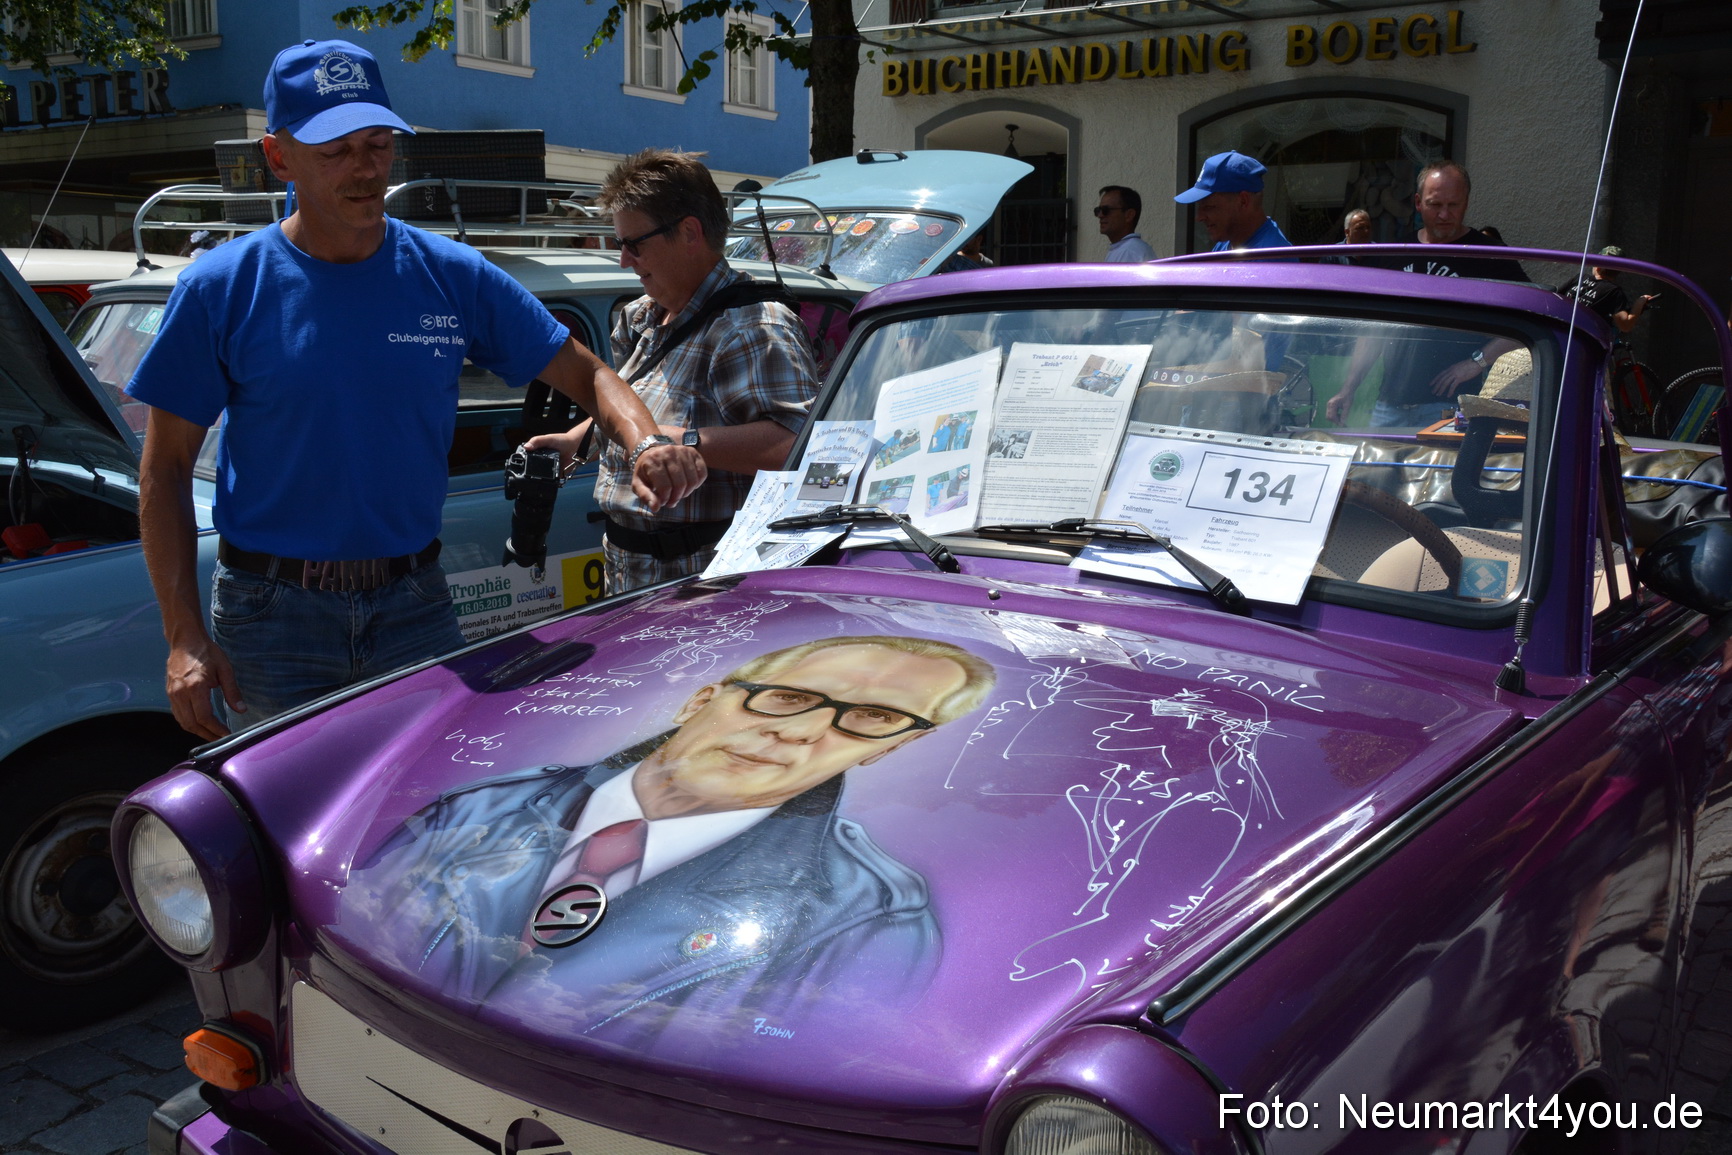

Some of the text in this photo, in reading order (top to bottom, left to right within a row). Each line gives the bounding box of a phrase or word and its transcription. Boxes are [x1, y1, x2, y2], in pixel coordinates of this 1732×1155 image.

[881, 10, 1477, 97] BUCHHANDLUNG BOEGL
[29, 68, 175, 124] PETER
[435, 315, 459, 328] BTC
[1224, 467, 1297, 506] 134
[1121, 504, 1154, 514] Teilnehmer
[1210, 516, 1240, 526] Fahrzeug
[450, 576, 511, 600] Trophäe
[459, 595, 508, 616] 16.05.2018
[459, 602, 562, 631] ationales IFA und Trabanttreffen
[464, 629, 485, 641] natico
[1129, 648, 1188, 670] NO
[504, 700, 633, 718] KNARREN
